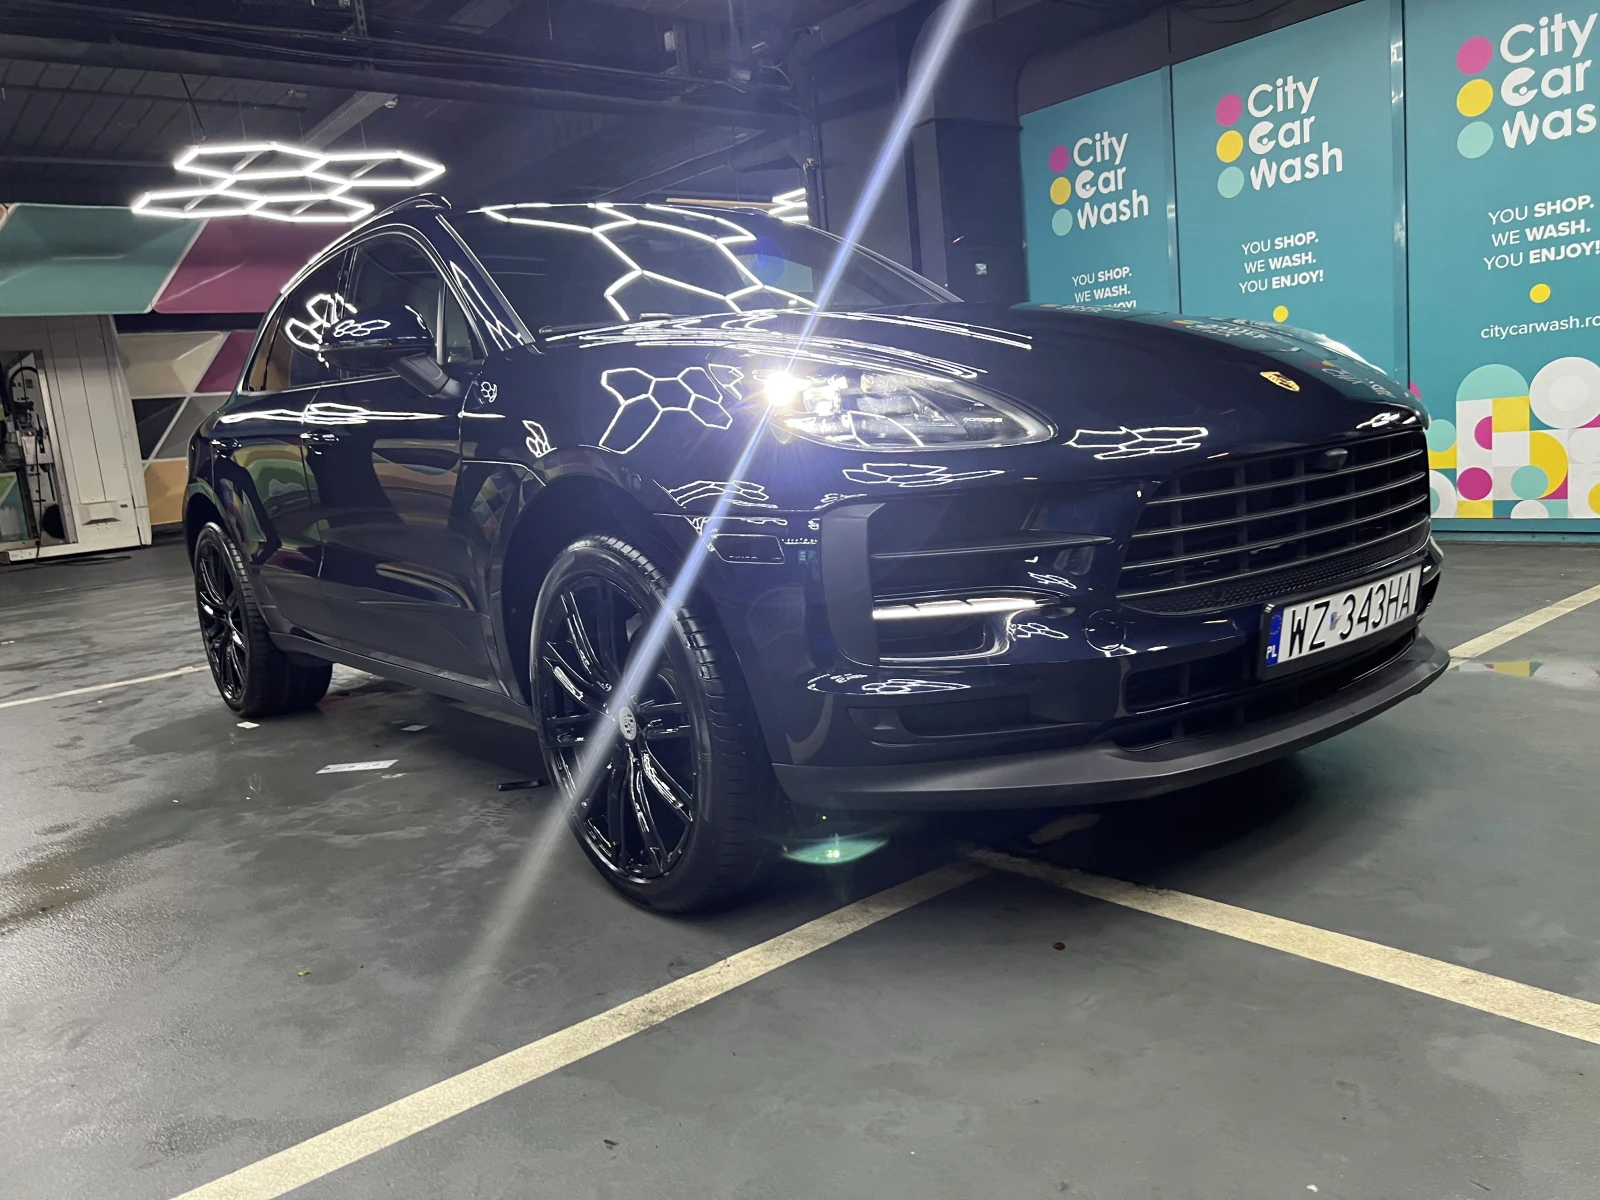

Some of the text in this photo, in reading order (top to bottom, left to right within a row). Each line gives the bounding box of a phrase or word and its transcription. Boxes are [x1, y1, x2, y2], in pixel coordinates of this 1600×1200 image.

[1500, 13, 1599, 63] City
[1248, 75, 1319, 118] City
[1501, 60, 1592, 107] Car
[1073, 131, 1128, 167] City
[1249, 115, 1316, 155] Car
[1075, 166, 1126, 199] Car
[1250, 142, 1343, 191] Wash
[1077, 189, 1149, 230] Wash
[1488, 194, 1595, 226] YOU SHOP.
[1241, 231, 1319, 256] YOU SHOP.
[1491, 218, 1592, 247] WE WASH.
[1244, 251, 1317, 274] WE WASH.
[1483, 240, 1600, 271] YOU ENJOY!
[1072, 266, 1132, 287] YOU SHOP.
[1239, 269, 1324, 294] YOU ENJOY!
[1074, 290, 1092, 304] WE
[1093, 283, 1131, 300] WASH.
[1287, 572, 1413, 658] WZ 343HA
[1266, 645, 1278, 660] PL
